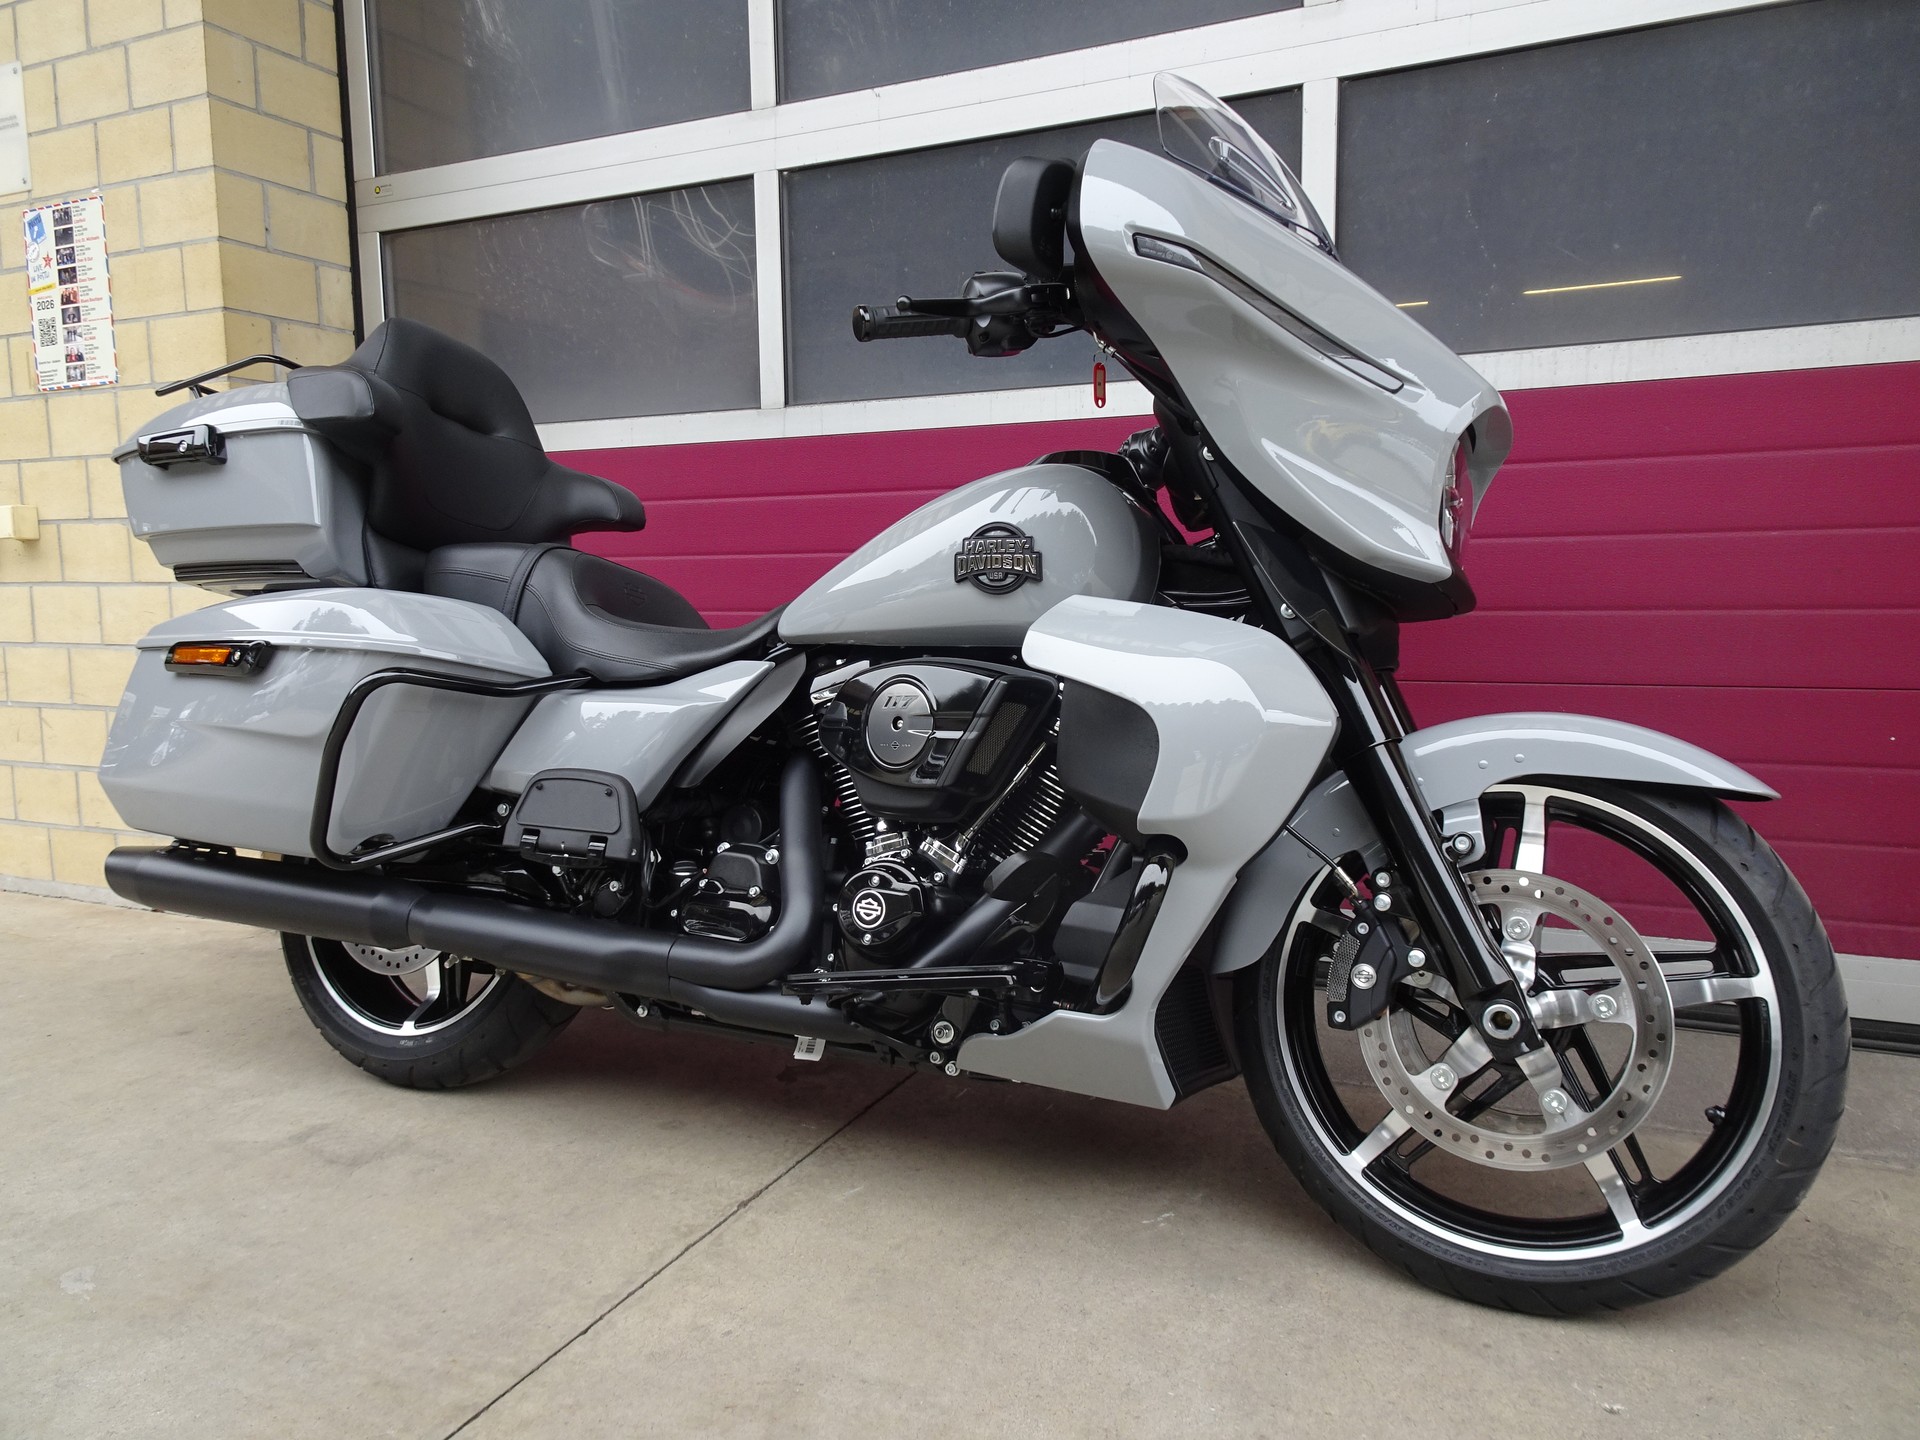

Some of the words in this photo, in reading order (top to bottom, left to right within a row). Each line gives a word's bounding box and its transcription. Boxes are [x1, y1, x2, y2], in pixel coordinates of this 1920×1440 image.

[36, 299, 55, 311] 2026
[964, 539, 1030, 554] HARLEY-
[957, 554, 1038, 576] DAVIDSON
[989, 572, 1003, 580] USA
[882, 695, 920, 711] 117
